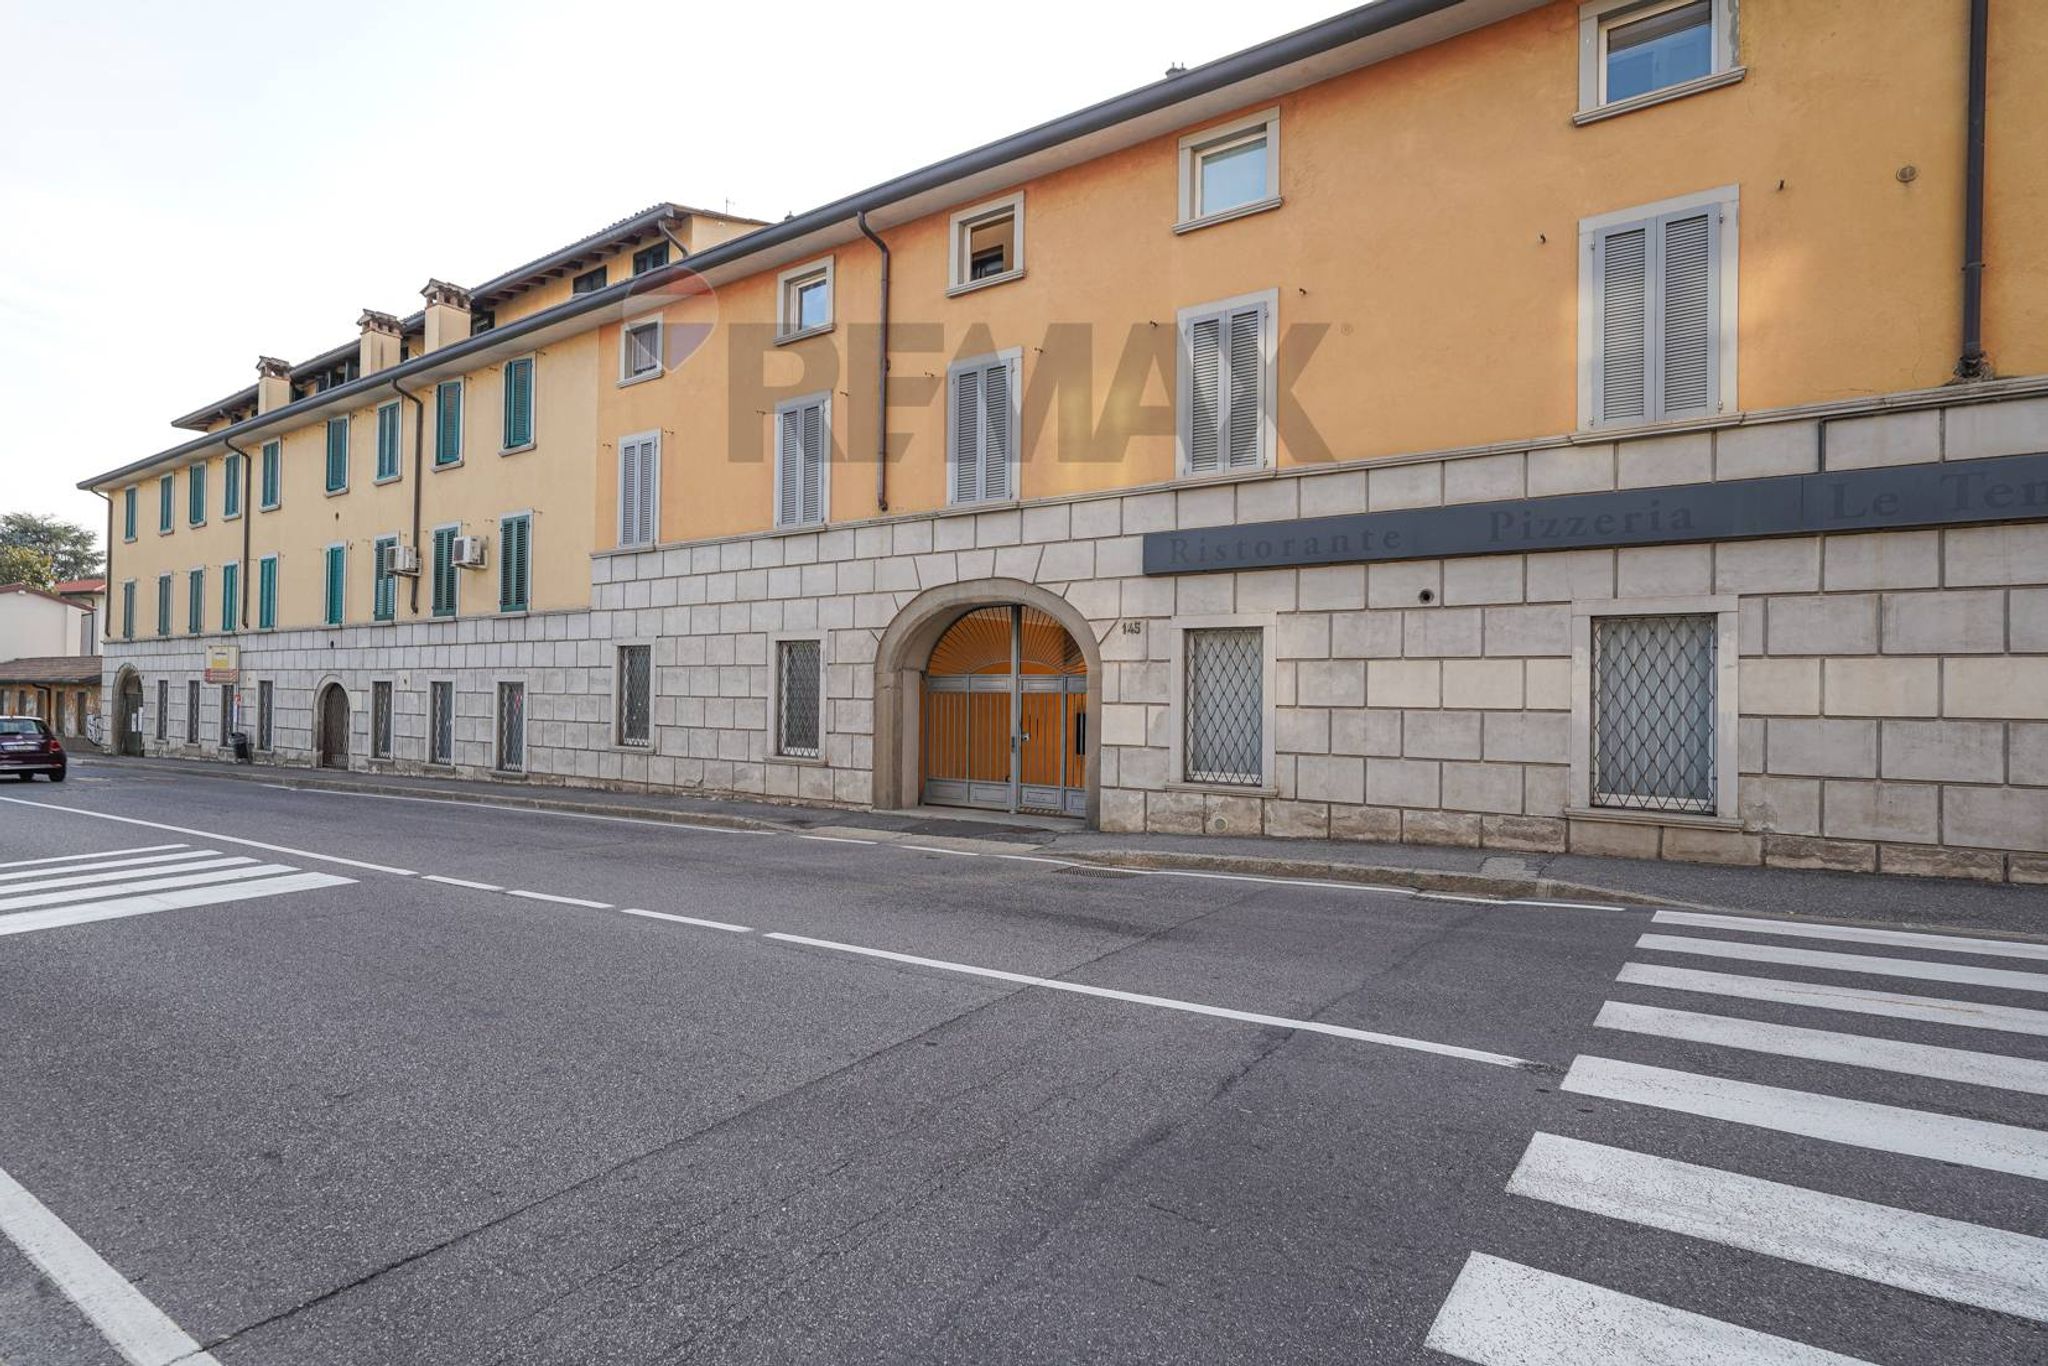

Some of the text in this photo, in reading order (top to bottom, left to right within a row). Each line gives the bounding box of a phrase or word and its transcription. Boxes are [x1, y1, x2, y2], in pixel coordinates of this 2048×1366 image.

[1169, 530, 1402, 564] Ristorante
[1488, 499, 1696, 542] Pizzeria
[1828, 482, 1900, 519] Le
[1122, 621, 1141, 635] 145
